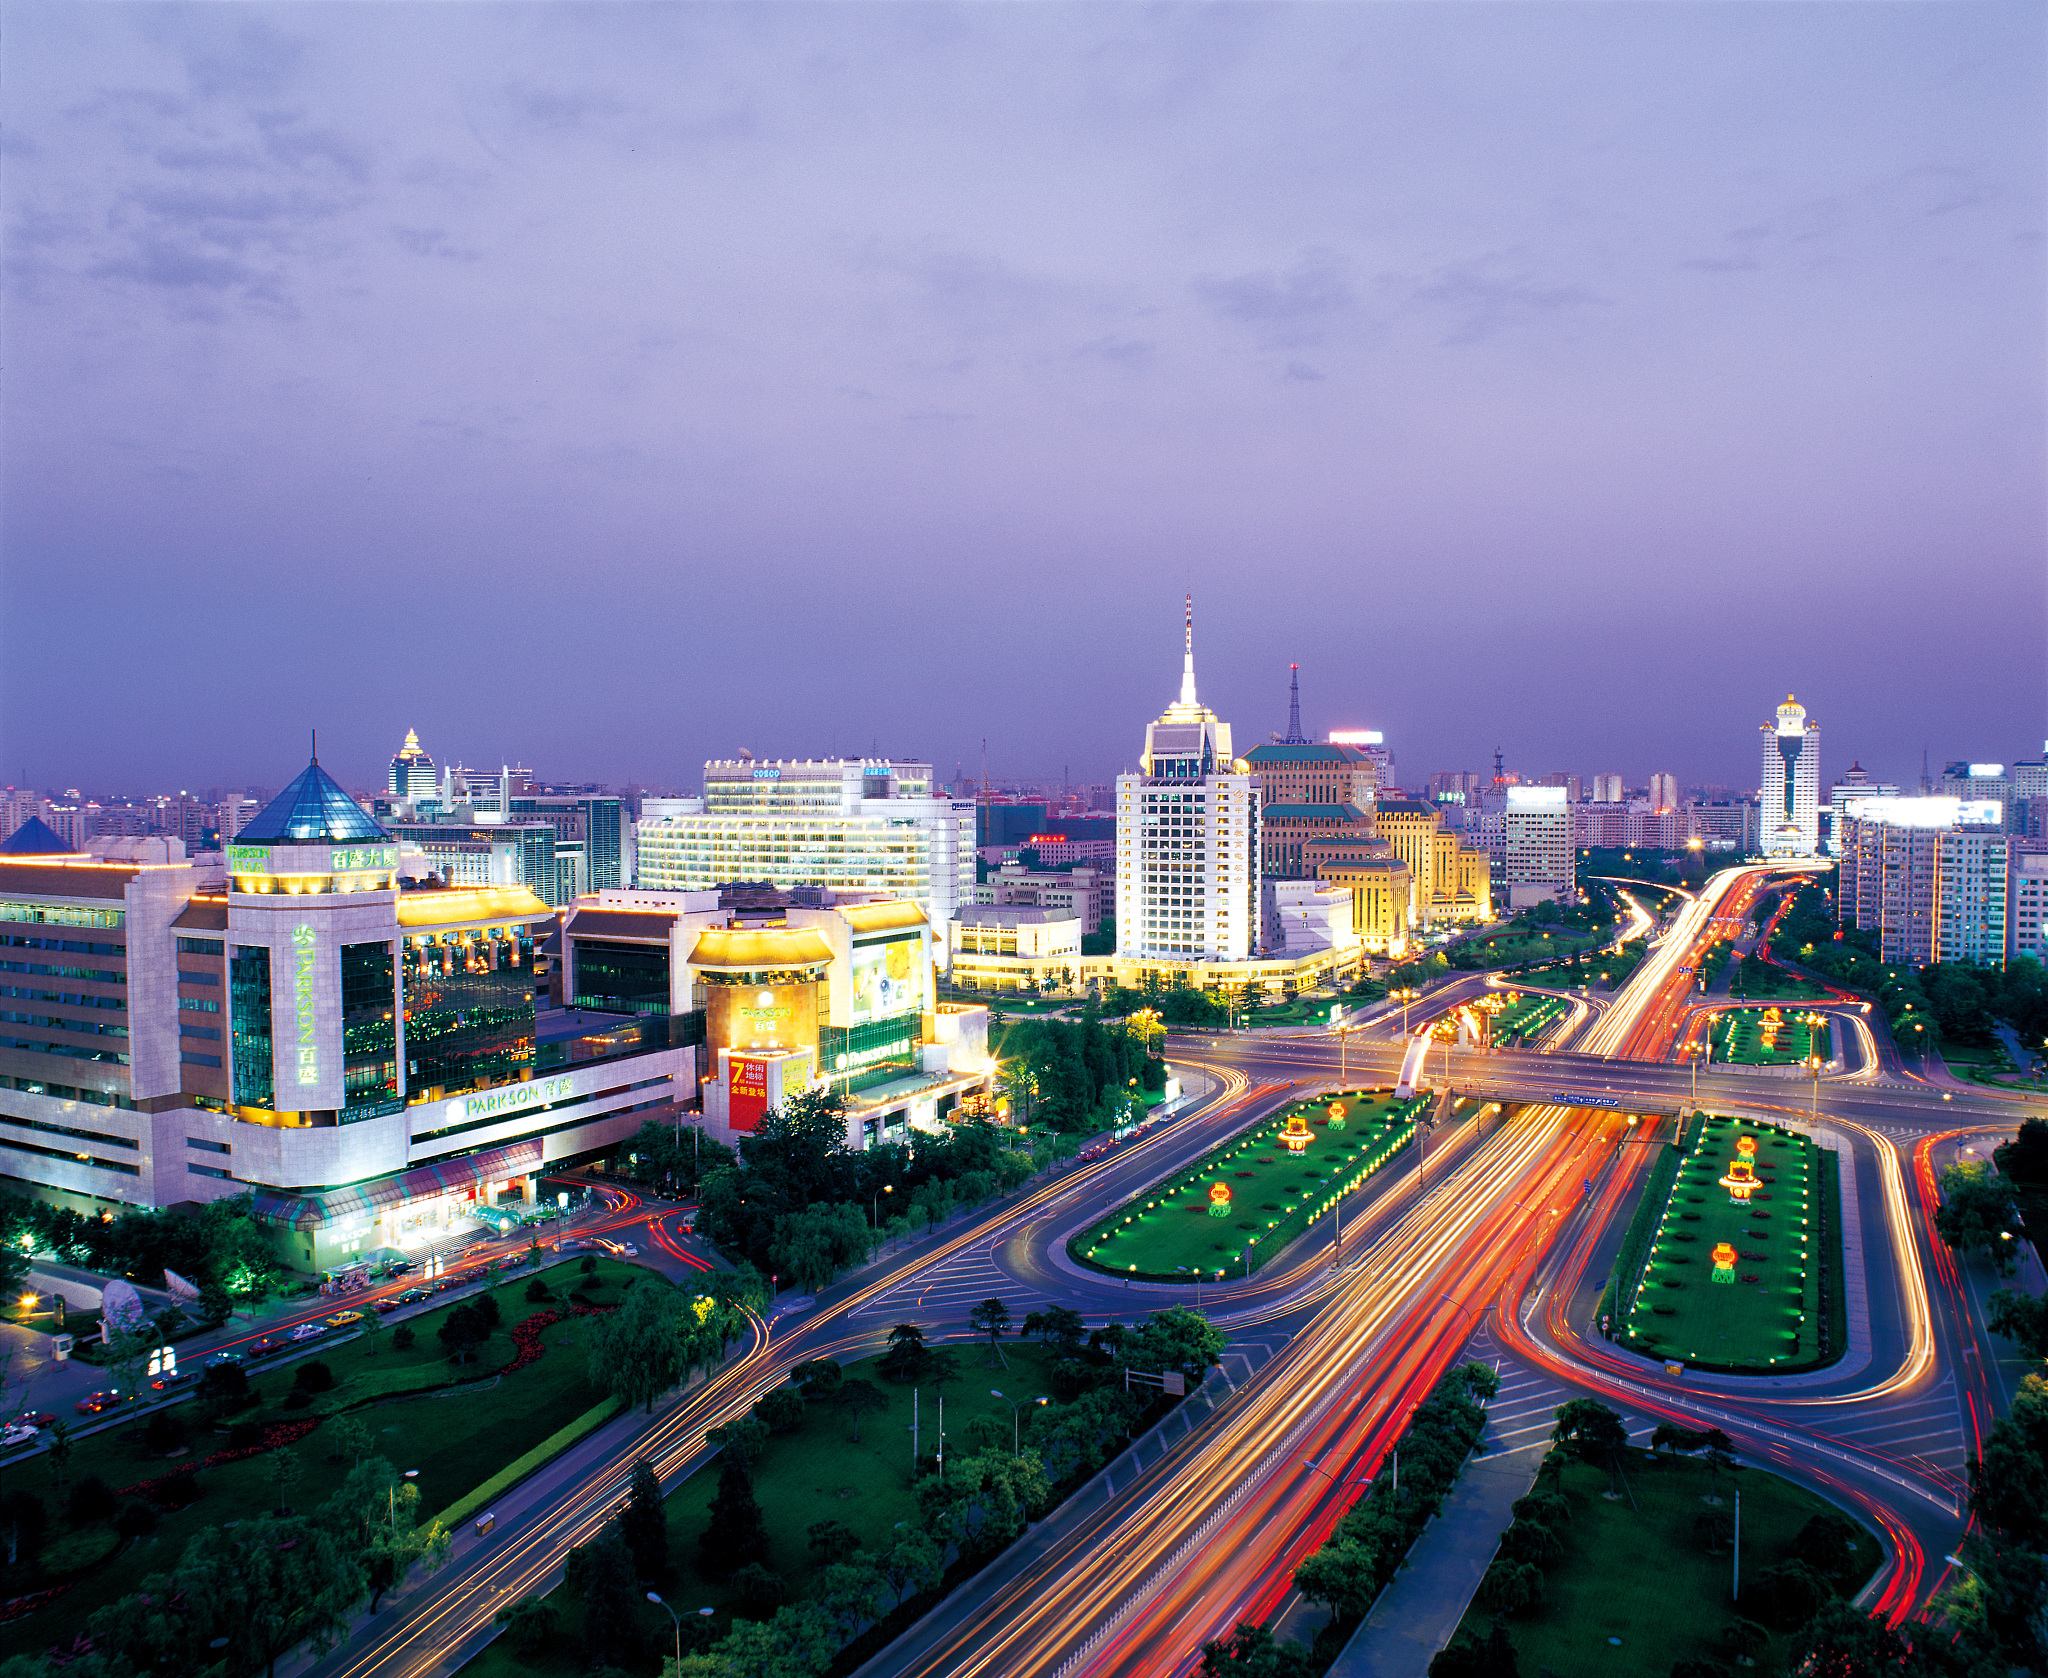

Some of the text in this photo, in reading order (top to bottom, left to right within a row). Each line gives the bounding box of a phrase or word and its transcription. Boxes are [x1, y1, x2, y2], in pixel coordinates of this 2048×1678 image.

[753, 769, 780, 778] COSCO
[227, 845, 270, 859] PARKSON
[1233, 807, 1244, 884] 中国教育电视台
[331, 848, 398, 869] 百盛大厦
[233, 860, 266, 873] PLAZA
[295, 949, 319, 1085] PARKSON 百盛
[740, 1007, 791, 1018] PARKSON
[745, 1071, 764, 1081] 地标
[731, 1085, 766, 1098] 全新登场
[466, 1086, 540, 1116] PARKSON
